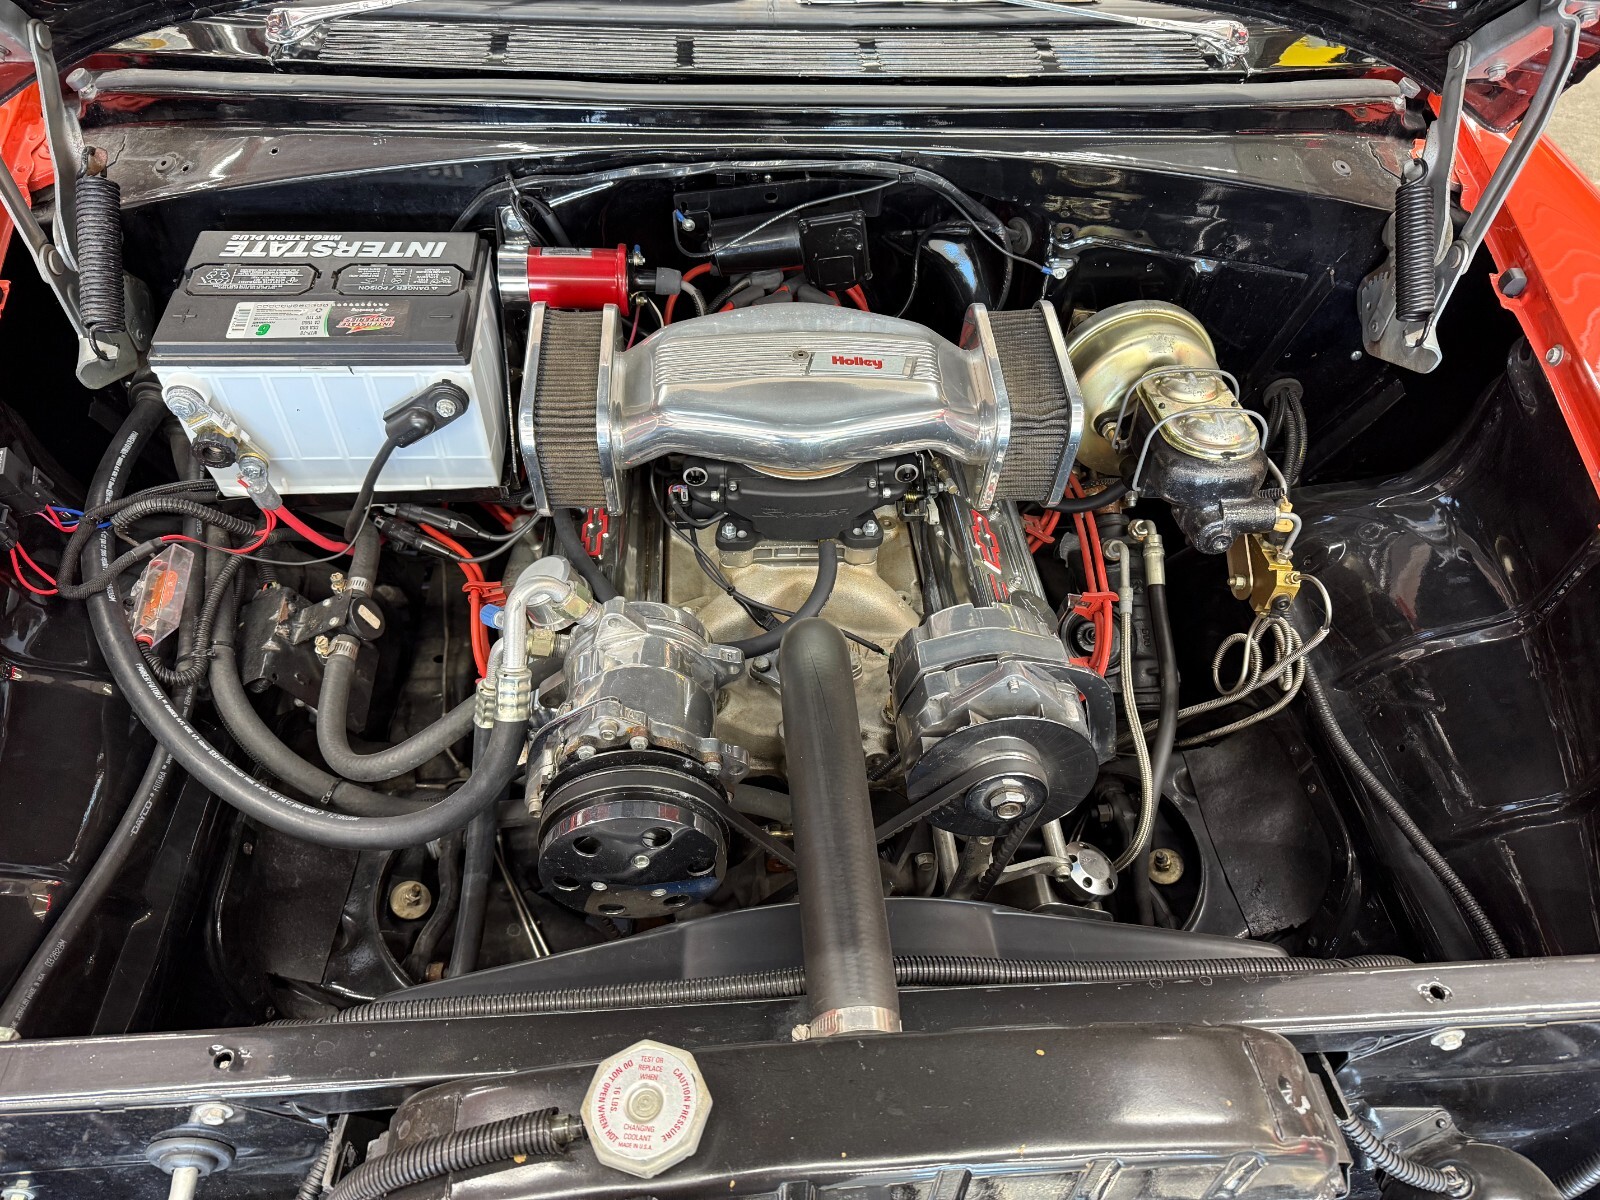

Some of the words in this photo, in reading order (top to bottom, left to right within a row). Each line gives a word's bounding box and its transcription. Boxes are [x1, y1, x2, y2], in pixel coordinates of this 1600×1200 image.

[230, 234, 263, 242] PLUS
[267, 234, 342, 242] MEGA-TRON
[219, 241, 448, 258] INTERSTATE
[255, 324, 271, 336] 6
[831, 355, 883, 369] Holley
[152, 771, 167, 792] FUTURA
[623, 1059, 634, 1069] DO
[638, 1064, 663, 1072] REPLACE
[608, 1066, 623, 1082] NOT
[673, 1068, 692, 1102] CAUTION
[598, 1082, 611, 1103] OPEN
[598, 1104, 609, 1130] WHEN
[661, 1104, 691, 1143] PRESSURE
[623, 1123, 655, 1132] CHANGING
[605, 1129, 619, 1143] HOT
[623, 1133, 652, 1142] COOLANT
